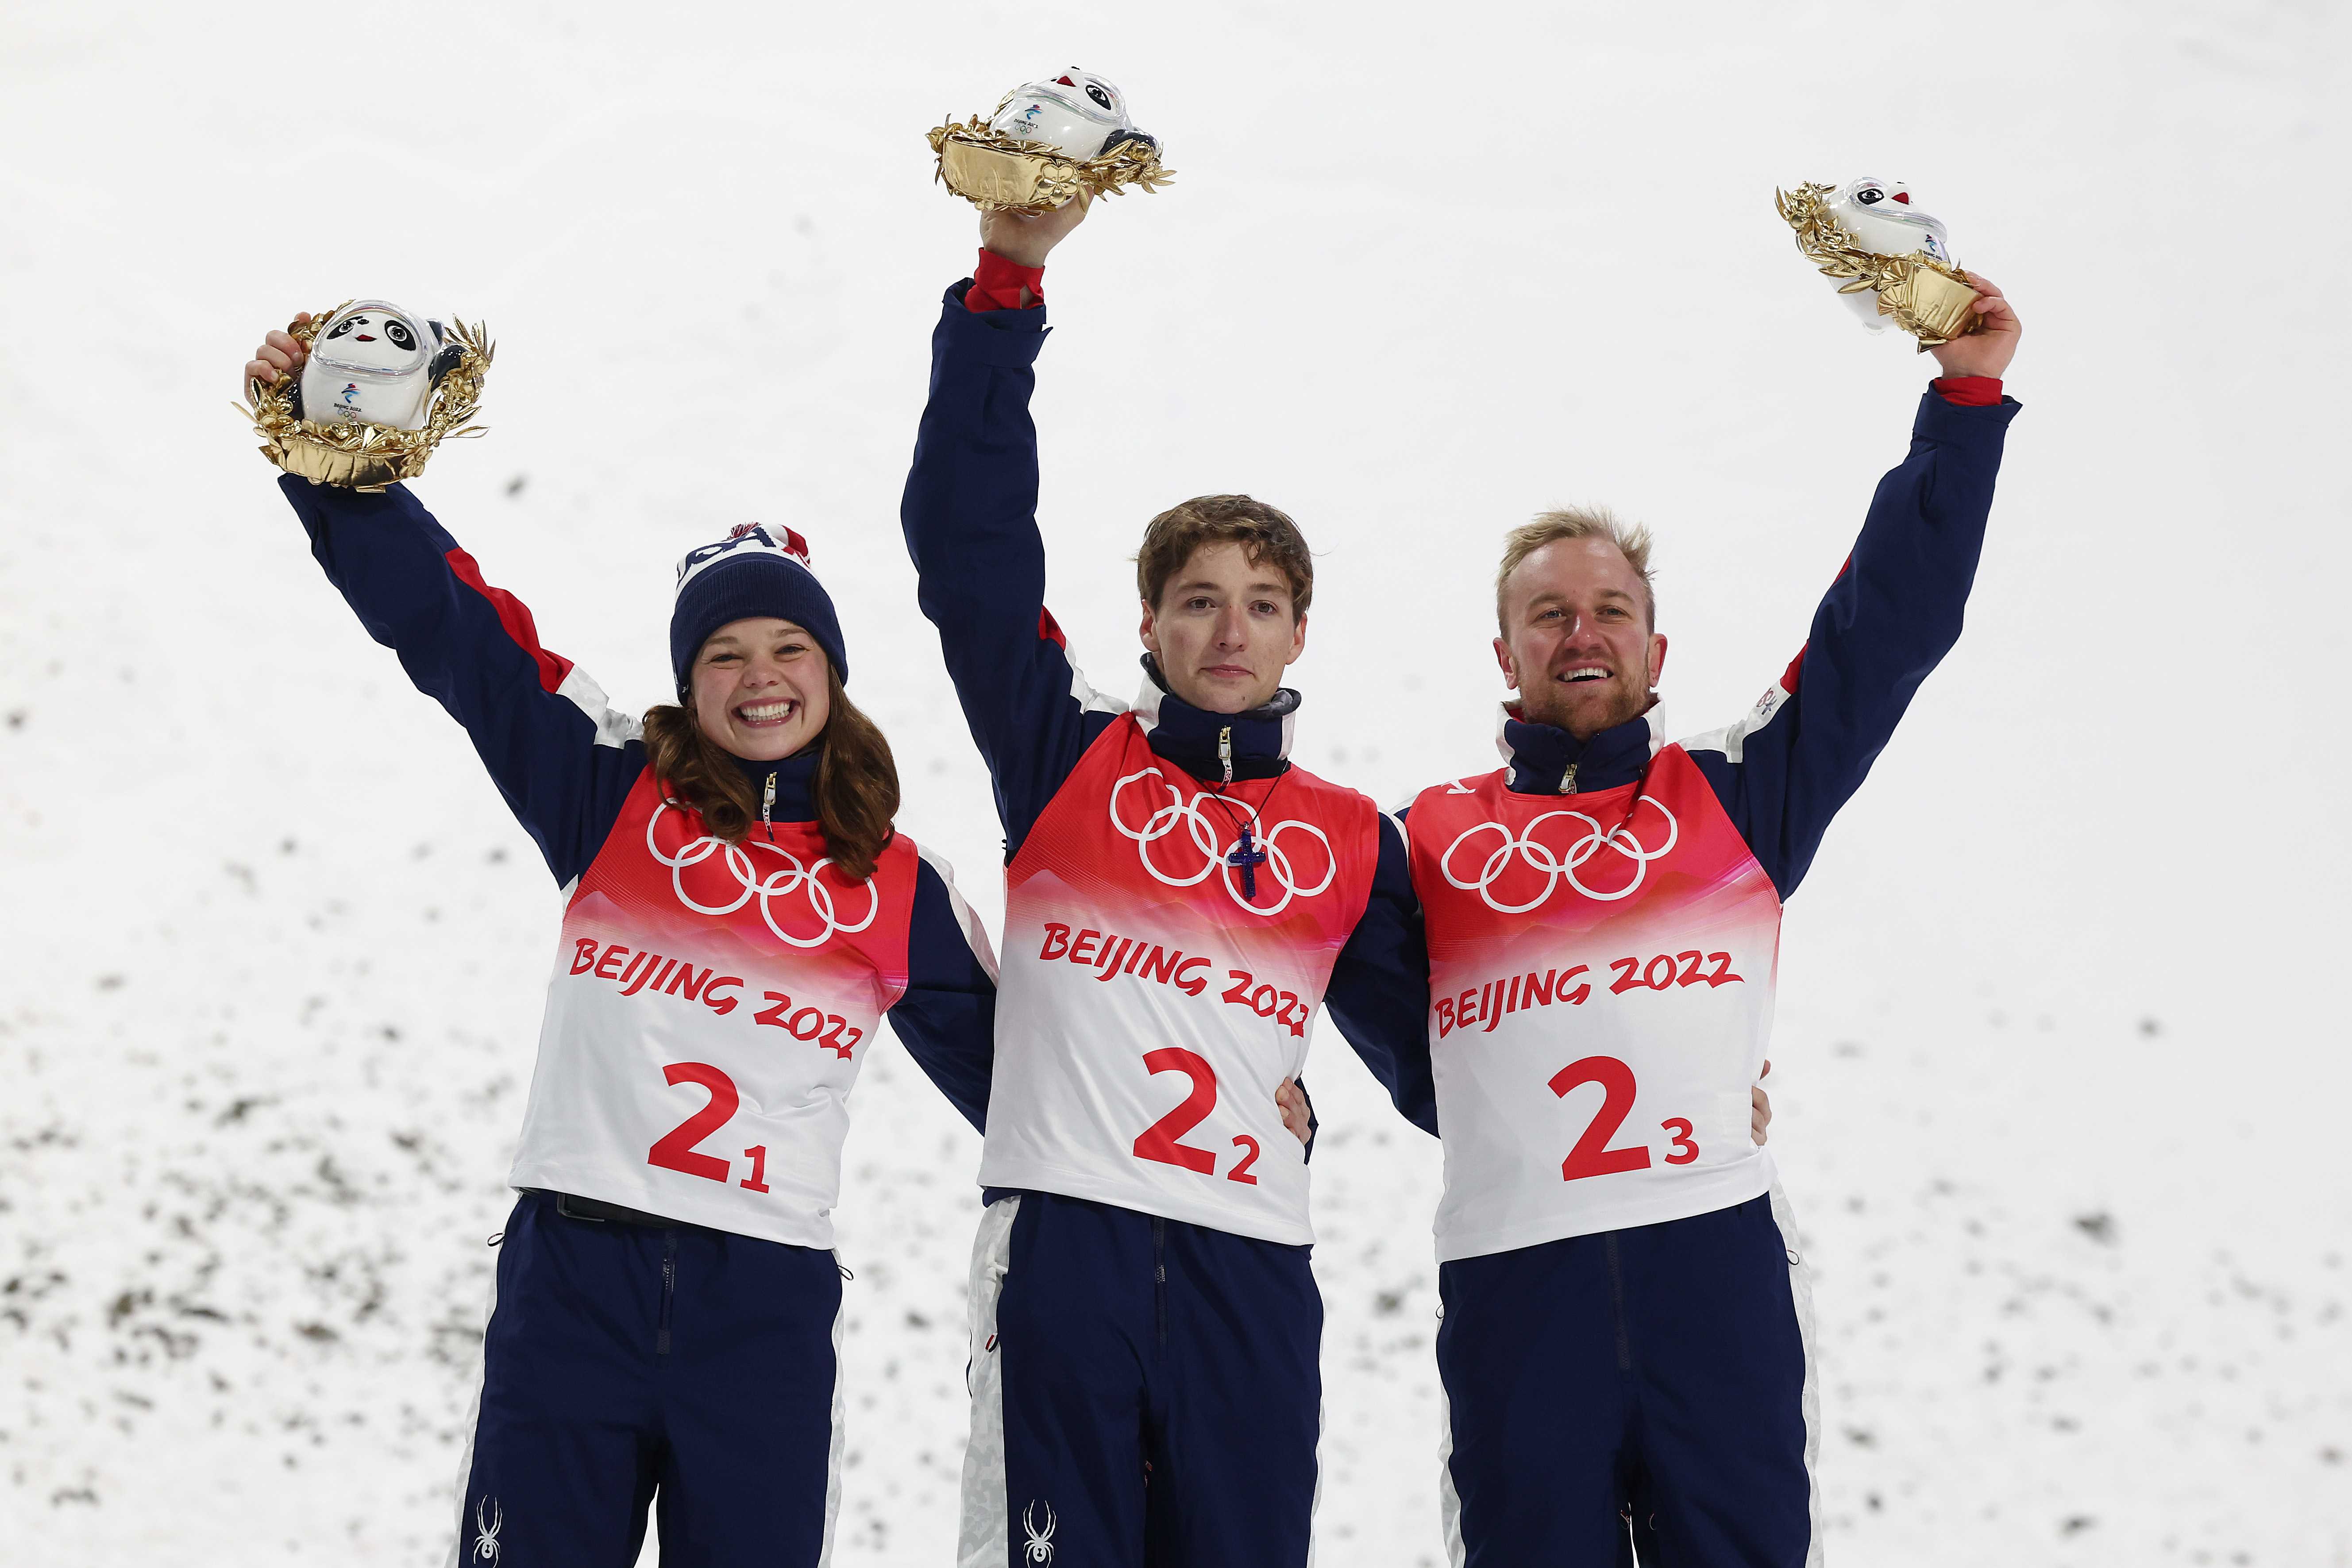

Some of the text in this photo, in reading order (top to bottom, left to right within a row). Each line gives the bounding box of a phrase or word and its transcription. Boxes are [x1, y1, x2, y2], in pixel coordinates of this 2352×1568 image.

[569, 938, 863, 1060] BEIJING 2022
[1040, 922, 1310, 1038] BEIJING 2022
[1434, 950, 1744, 1039] BEIJING 2022
